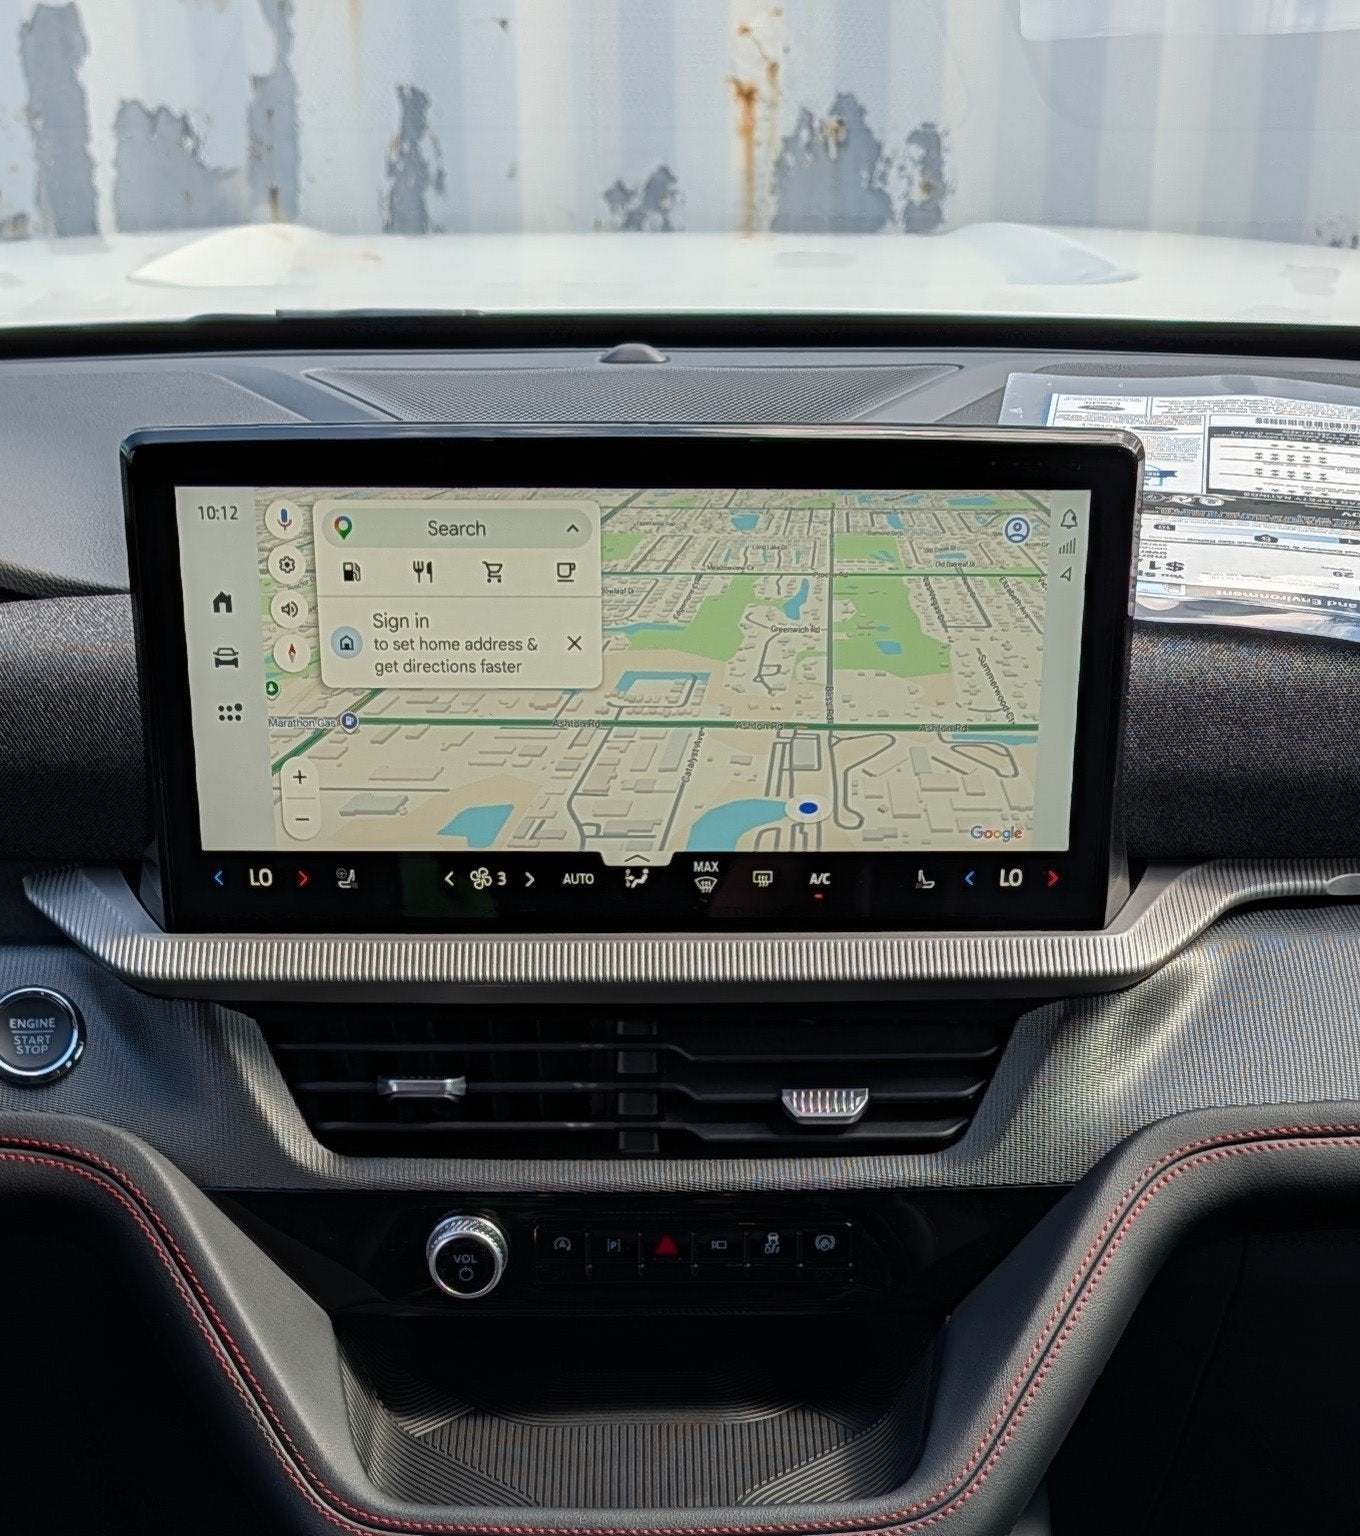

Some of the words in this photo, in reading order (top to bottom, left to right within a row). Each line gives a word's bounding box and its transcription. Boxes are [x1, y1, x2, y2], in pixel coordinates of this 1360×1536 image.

[197, 505, 239, 521] 10:12
[427, 520, 487, 537] Search
[999, 576, 1021, 607] Elizabeth
[1019, 606, 1031, 619] Ave
[1214, 589, 1322, 607] Environment
[1326, 600, 1358, 609] and
[372, 613, 409, 633] Sign
[415, 614, 430, 629] in
[771, 625, 808, 633] Greenwich
[374, 639, 389, 652] to
[393, 639, 415, 652] set
[419, 637, 461, 651] home
[465, 637, 523, 651] address
[527, 638, 538, 651] &
[375, 661, 399, 679] get
[403, 660, 477, 674] directions
[480, 660, 522, 674] faster
[977, 654, 1009, 711] Summerwood
[268, 717, 315, 728] Marathon
[316, 718, 337, 728] Gas
[552, 719, 584, 727] Ashton
[586, 719, 601, 727] Rd
[735, 721, 769, 730] Ashton
[771, 722, 784, 730] Rd
[919, 723, 951, 733] Ashton
[953, 724, 968, 733] Rd
[681, 749, 700, 782] Catalyst
[970, 825, 1023, 843] Google
[693, 862, 719, 873] MAX
[249, 868, 273, 887] LO
[497, 871, 507, 886] 3
[562, 872, 595, 885] AUTO
[809, 872, 831, 886] A/C
[999, 868, 1023, 887] LO
[8, 1017, 56, 1029] ENGINE
[14, 1035, 52, 1045] START
[16, 1045, 49, 1055] STOP
[763, 1245, 781, 1255] OFF
[453, 1253, 478, 1265] VOL
